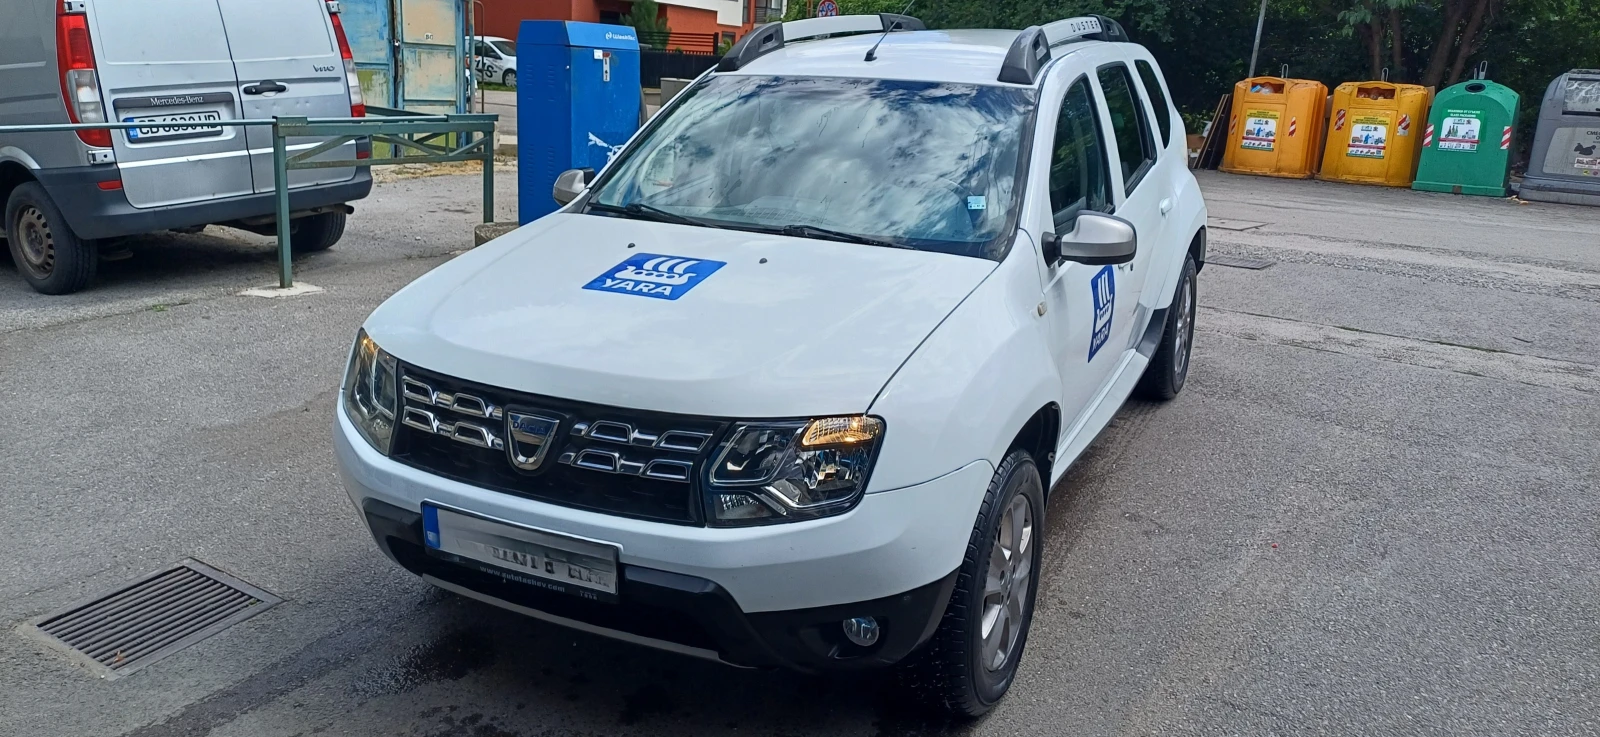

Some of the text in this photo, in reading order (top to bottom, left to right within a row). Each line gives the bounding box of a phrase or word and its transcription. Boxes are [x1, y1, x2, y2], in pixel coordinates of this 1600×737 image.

[1070, 20, 1099, 33] DUSTER
[150, 96, 204, 106] Mercedes-Benz
[602, 278, 673, 296] YARA
[1091, 322, 1110, 353] YARA
[512, 421, 546, 434] DACIA
